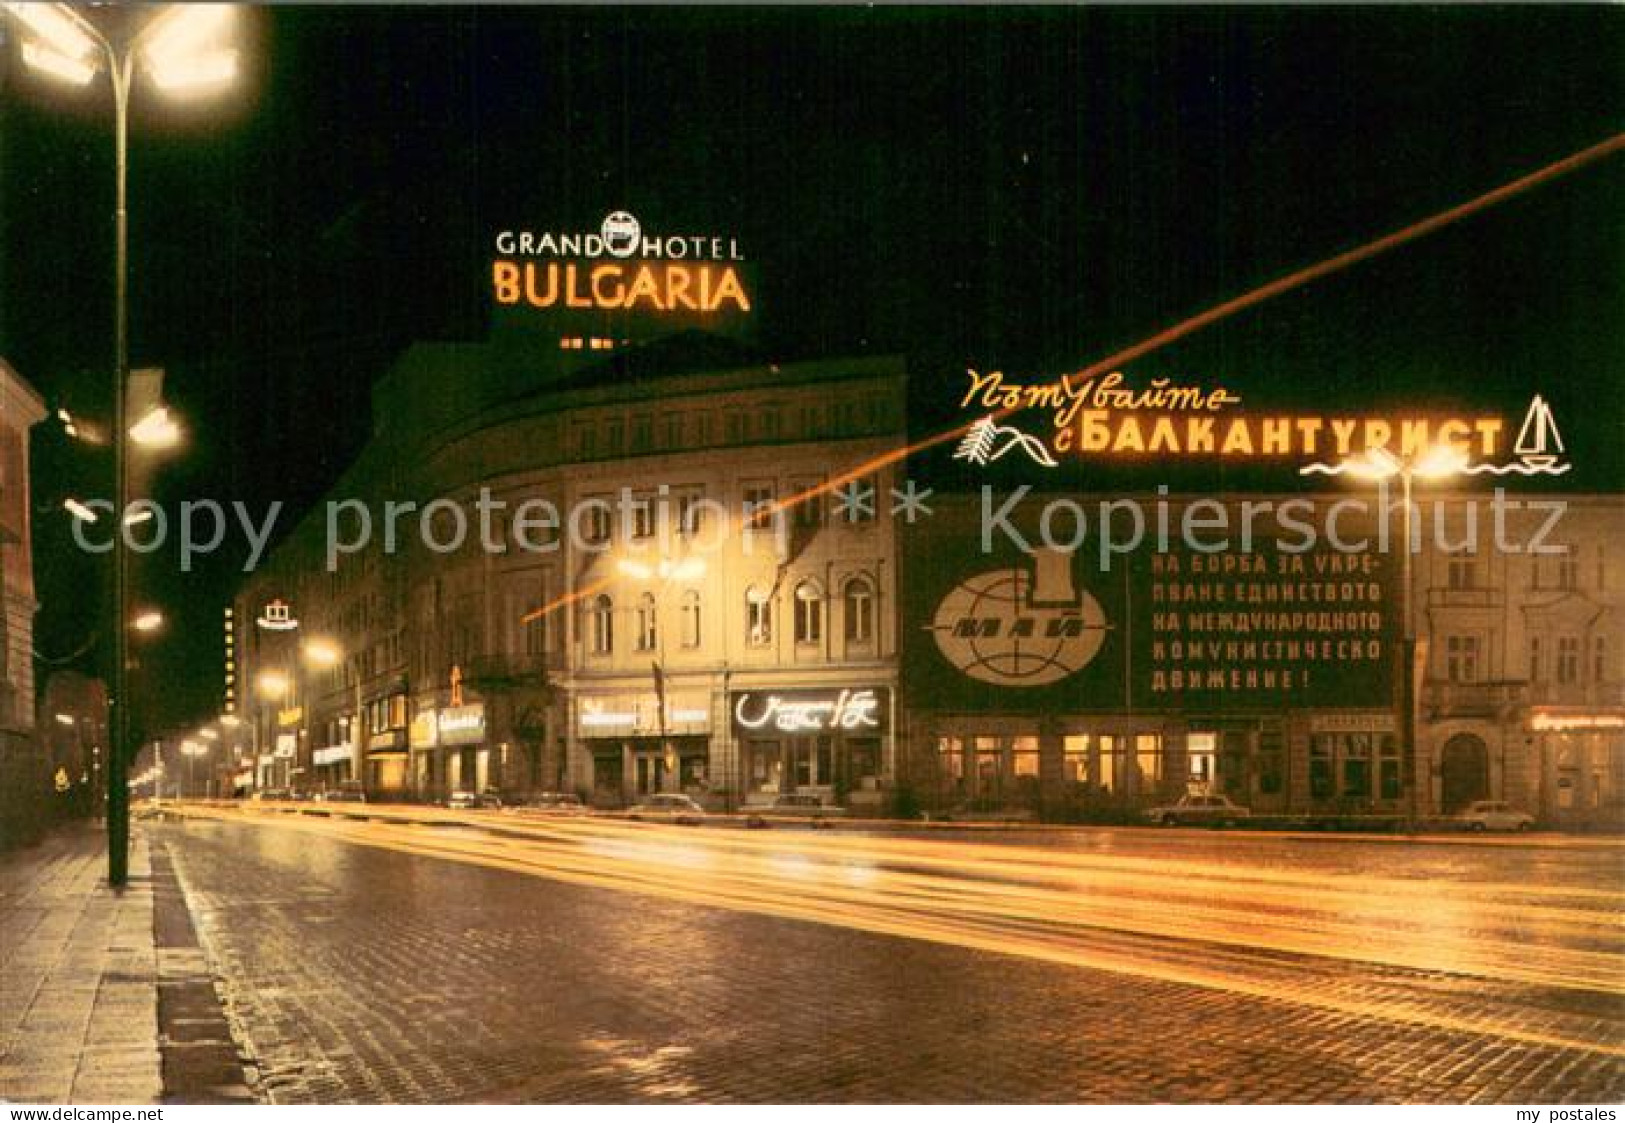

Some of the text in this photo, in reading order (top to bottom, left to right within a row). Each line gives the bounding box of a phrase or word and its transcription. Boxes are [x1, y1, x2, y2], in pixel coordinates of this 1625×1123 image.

[496, 231, 744, 260] GRAND HOTEL
[493, 261, 750, 312] BULGARIA
[1080, 410, 1503, 456] БАЛКАНТУРИСТ
[1153, 554, 1179, 575] НА
[1192, 554, 1266, 575] БОРБА
[1278, 554, 1303, 575] ЗА
[1234, 583, 1380, 603] ЕДИНСТВОТО
[1152, 612, 1380, 632] НА МЕЖДУНАРОДНОТО
[1153, 640, 1380, 660] КОМУНИСТИЧЕСКО
